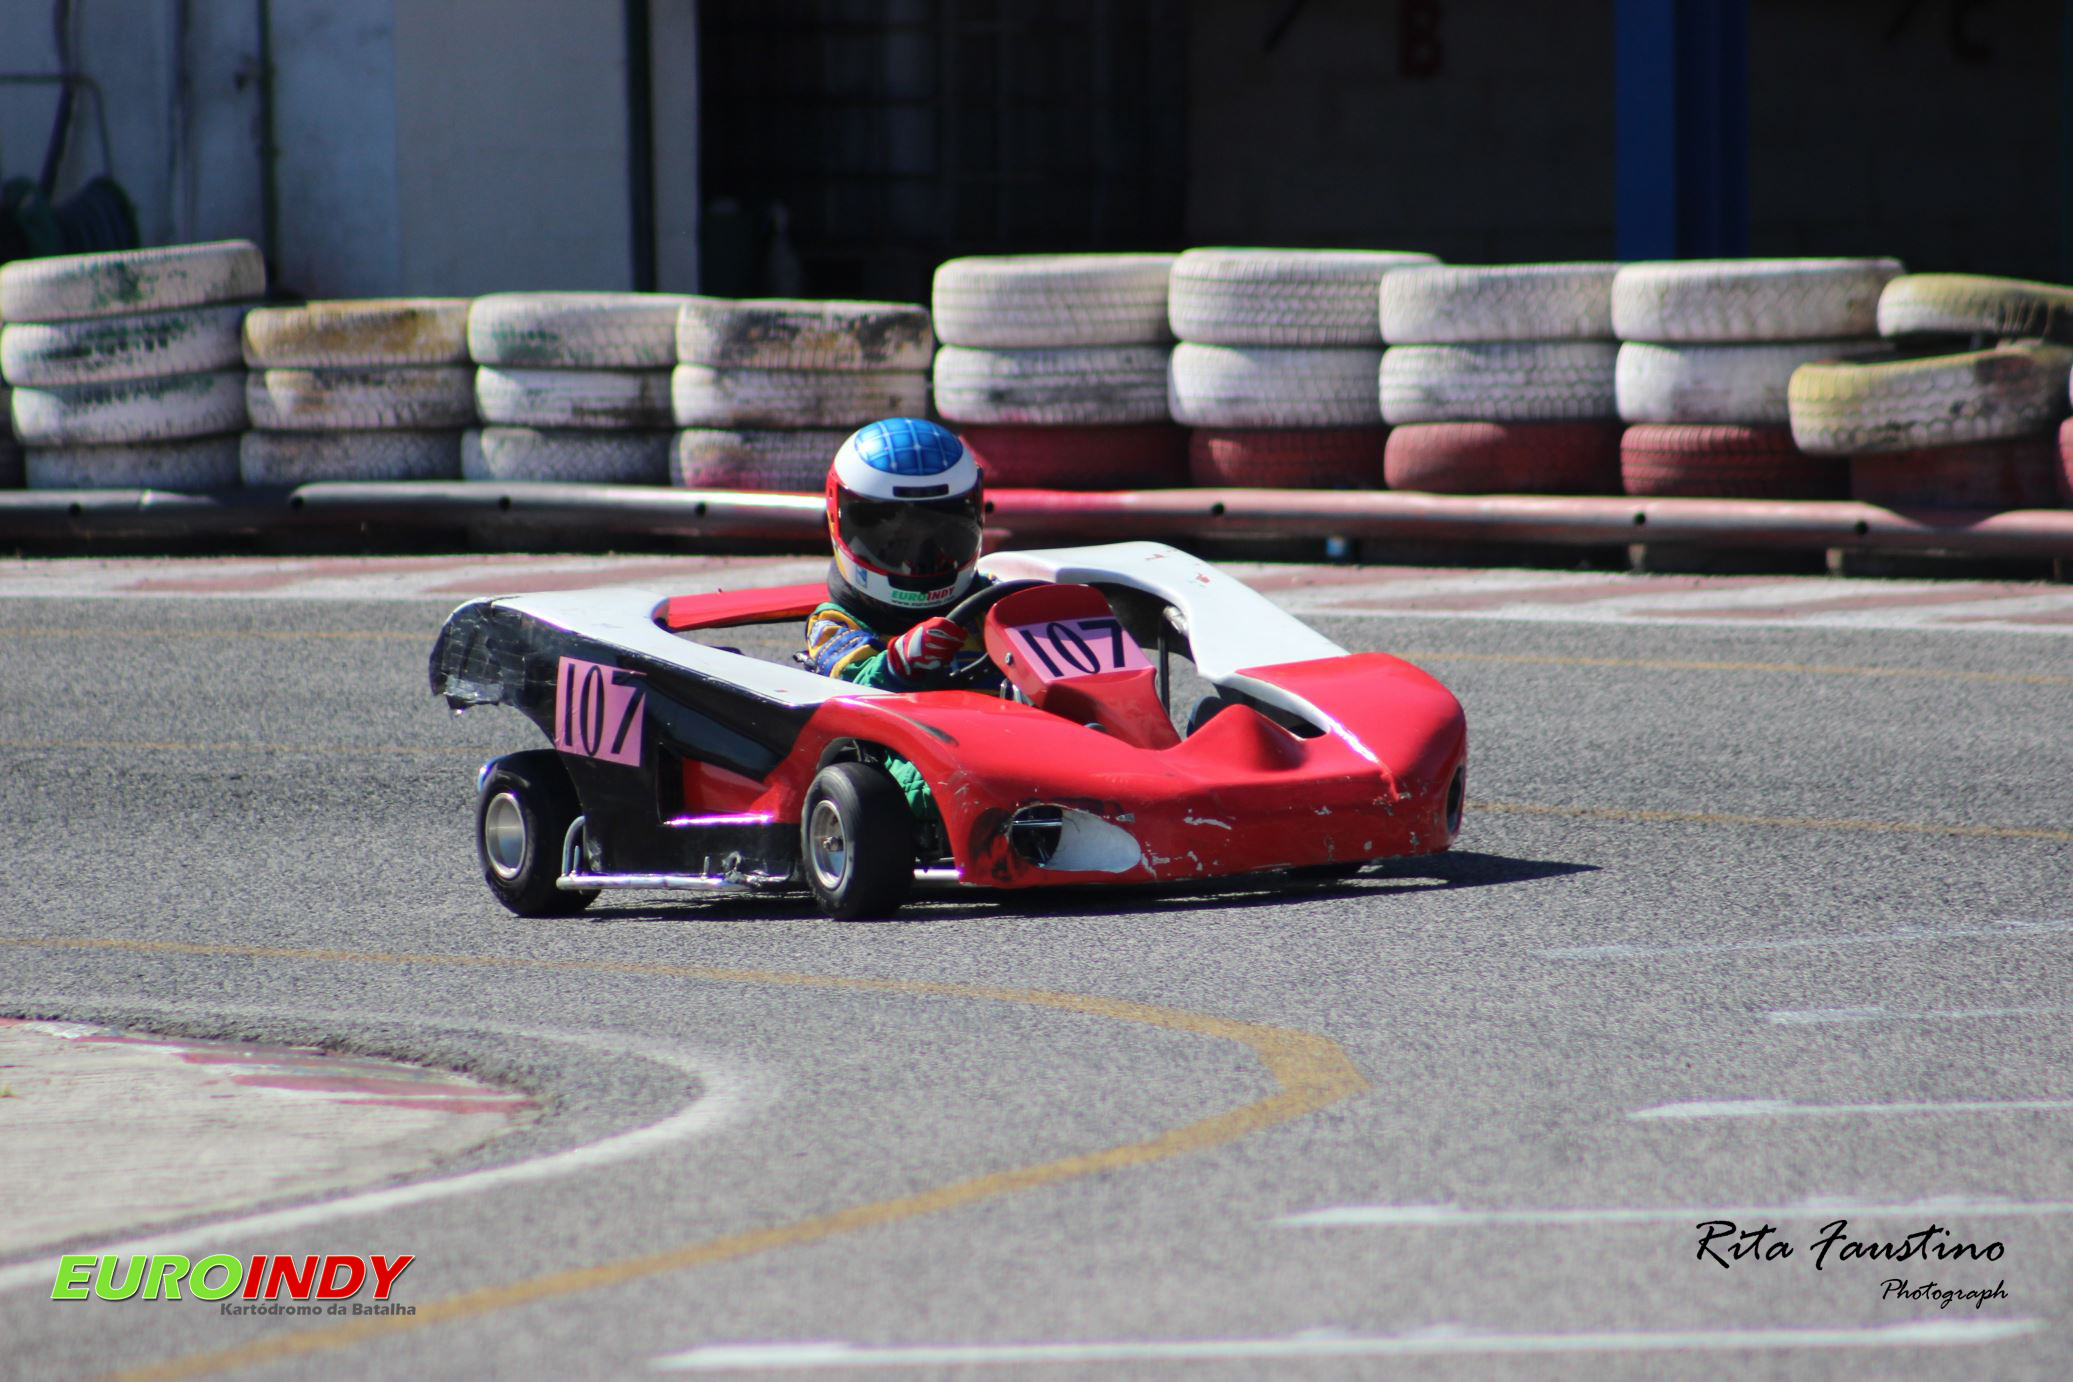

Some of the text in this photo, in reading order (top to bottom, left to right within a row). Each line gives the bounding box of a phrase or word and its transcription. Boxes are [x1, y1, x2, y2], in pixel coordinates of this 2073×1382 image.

[891, 586, 956, 602] EUROINDY
[1019, 619, 1125, 677] 107
[564, 662, 646, 757] 107
